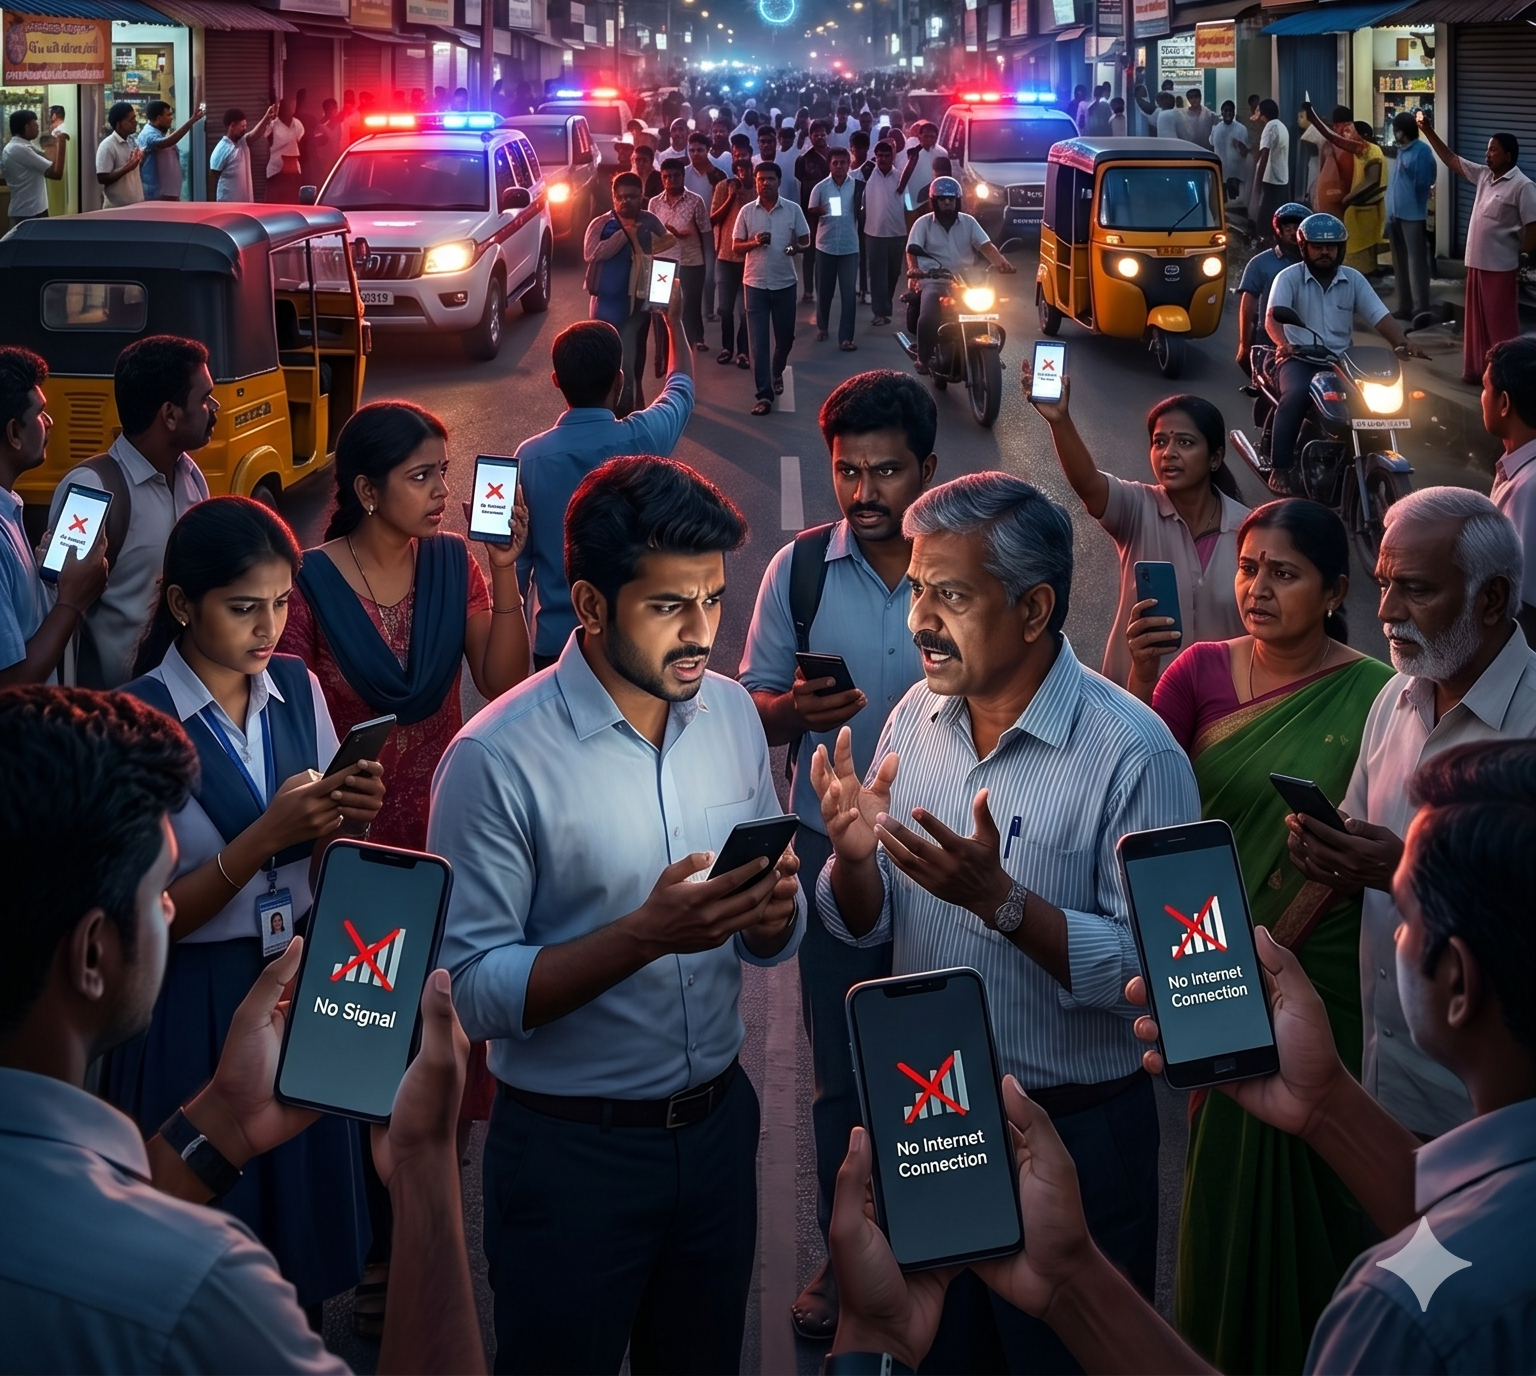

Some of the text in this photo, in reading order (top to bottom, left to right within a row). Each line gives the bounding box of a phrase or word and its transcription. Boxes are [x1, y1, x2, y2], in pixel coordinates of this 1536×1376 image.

[1168, 965, 1243, 990] No Internet
[1171, 984, 1248, 1008] Connection
[313, 996, 397, 1029] No Signal
[896, 1129, 986, 1157] No Internet
[898, 1152, 988, 1178] Connection
